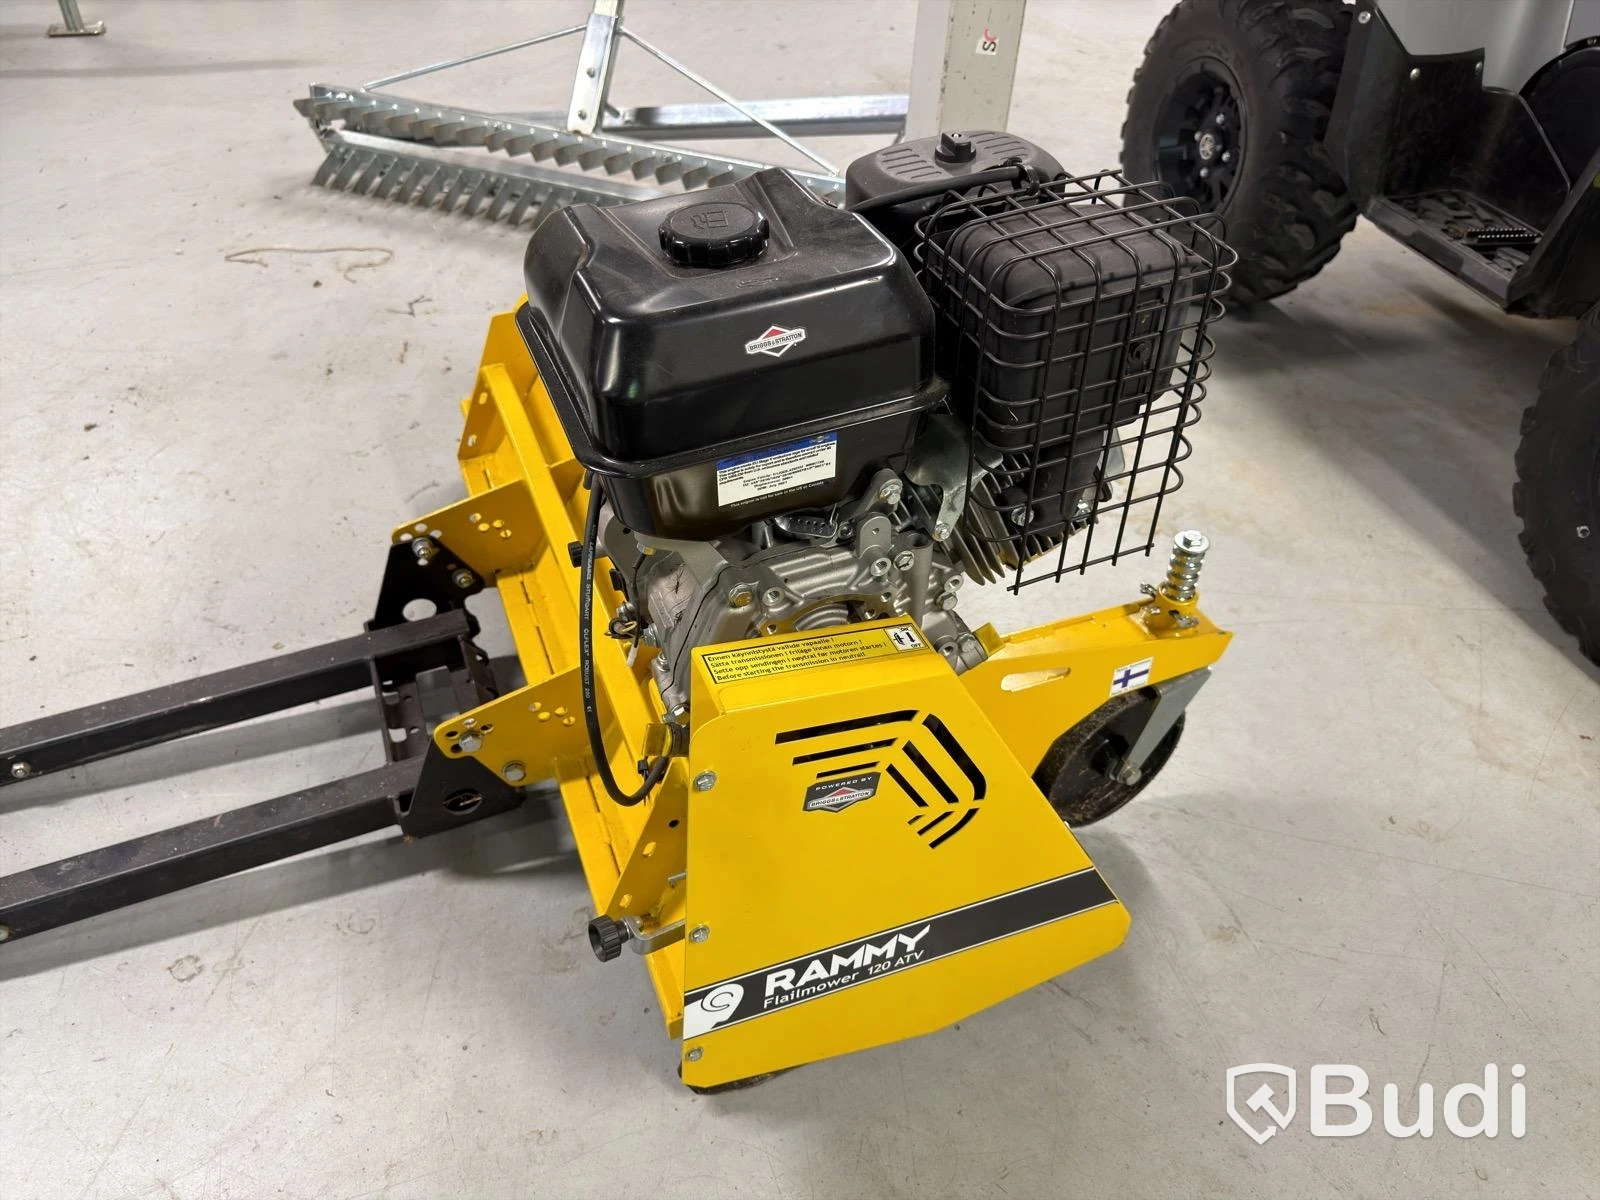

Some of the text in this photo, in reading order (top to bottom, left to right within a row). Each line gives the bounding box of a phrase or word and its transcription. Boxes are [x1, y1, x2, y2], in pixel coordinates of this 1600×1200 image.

[716, 672, 742, 682] Before
[742, 667, 771, 677] starting
[785, 657, 829, 670] transmission
[816, 780, 858, 790] POWERED
[763, 950, 924, 1009] Flailmower 120 ATV
[765, 924, 931, 997] RAMMY
